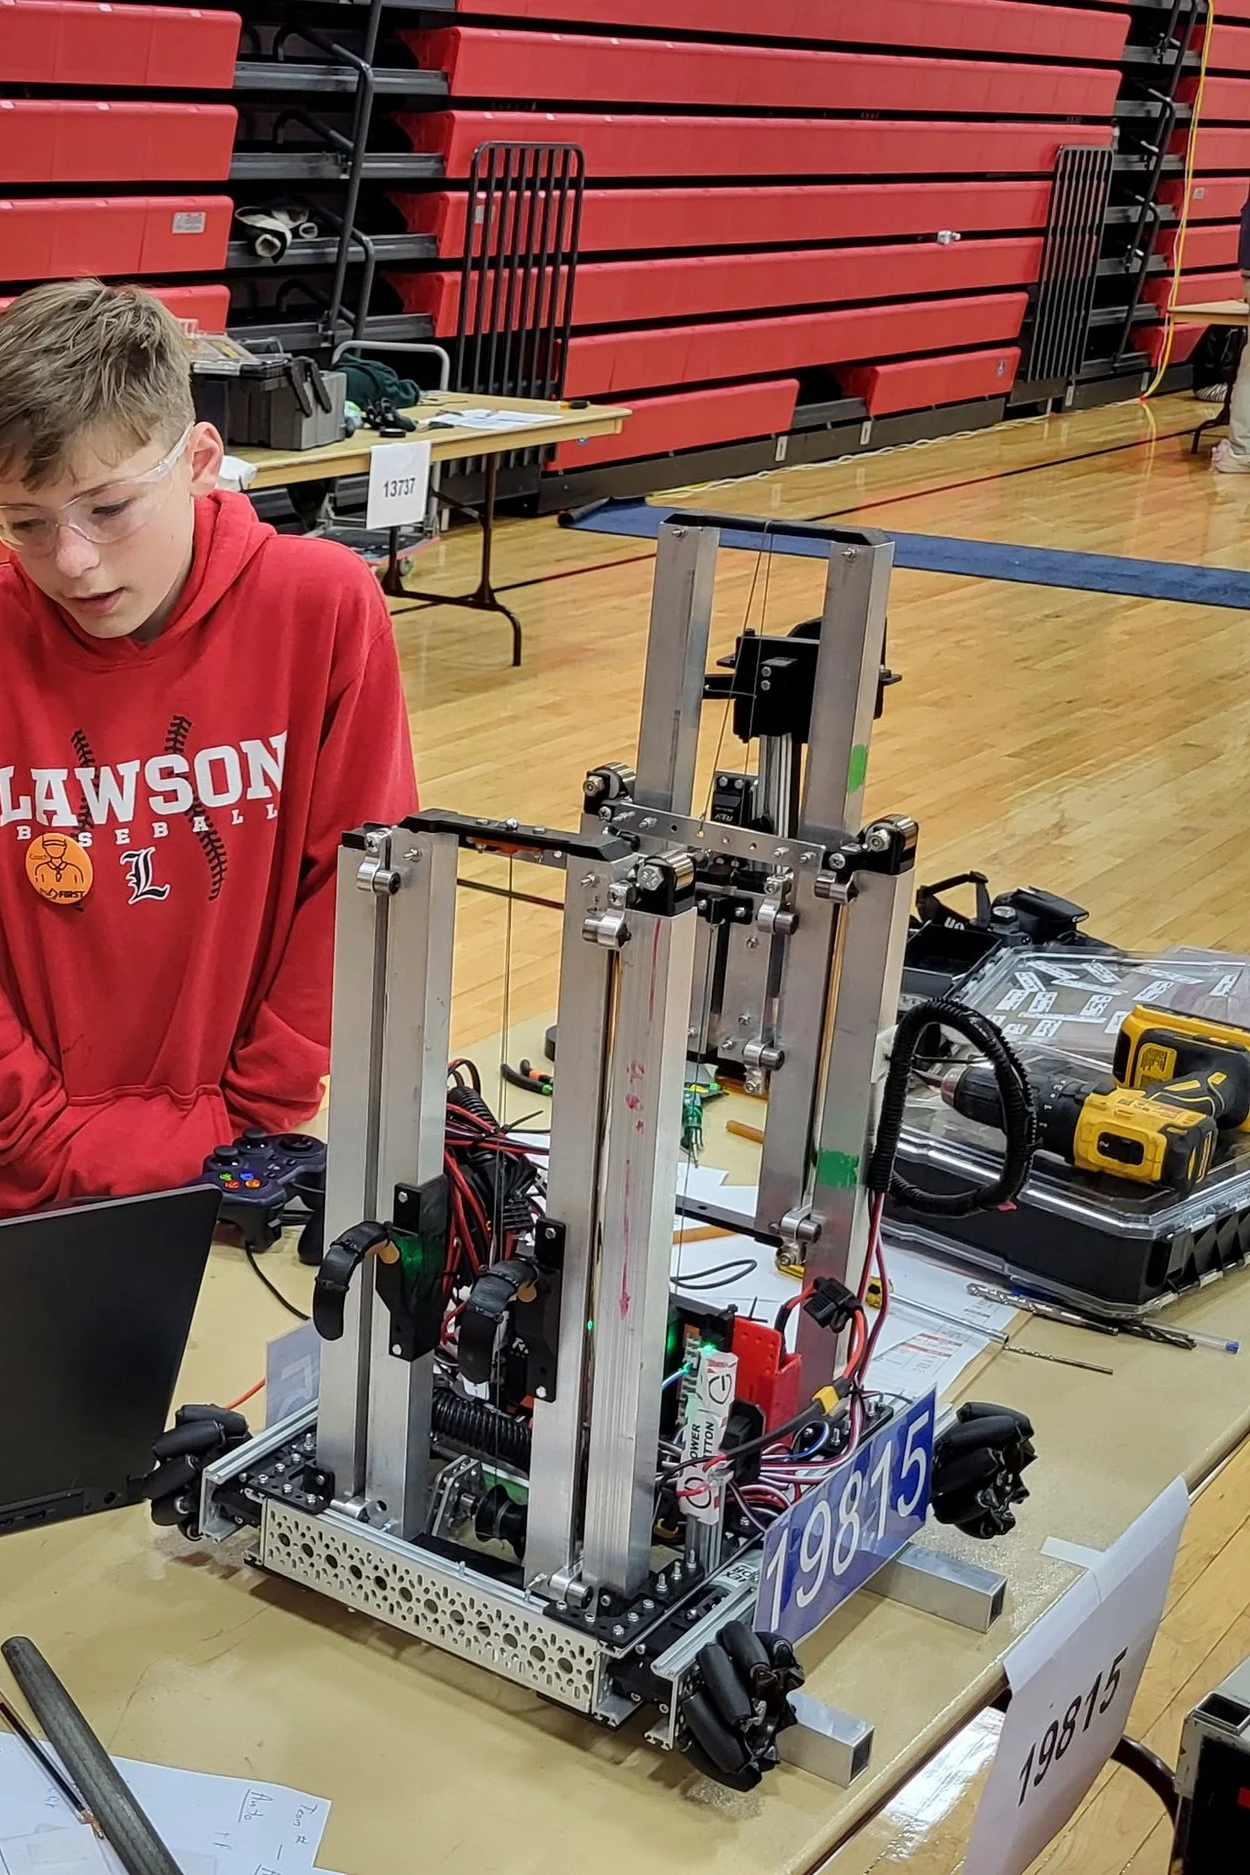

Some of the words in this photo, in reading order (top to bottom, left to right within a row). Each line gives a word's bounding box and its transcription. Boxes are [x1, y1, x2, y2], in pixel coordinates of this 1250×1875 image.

[382, 477, 416, 498] 13737
[16, 803, 279, 848] BSEBALL
[58, 890, 86, 898] FIRST
[766, 1410, 929, 1633] 19815
[1017, 1645, 1129, 1808] 19815
